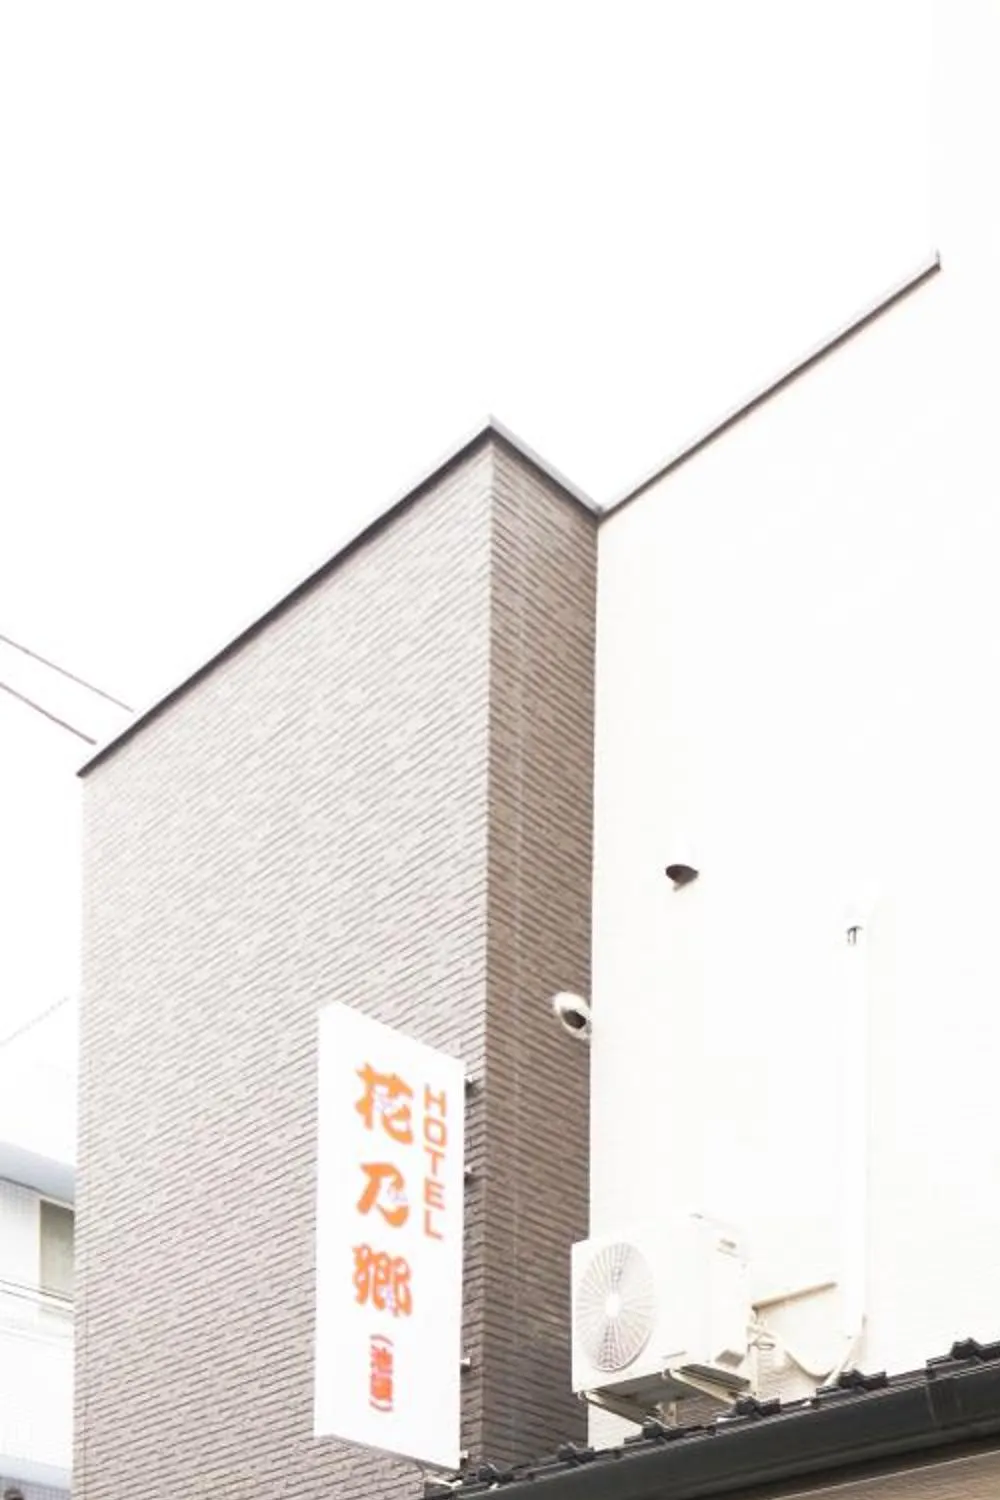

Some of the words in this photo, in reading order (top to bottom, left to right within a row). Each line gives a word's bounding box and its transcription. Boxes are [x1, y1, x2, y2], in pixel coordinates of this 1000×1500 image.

[353, 1062, 414, 1318] 花乃郷
[424, 1084, 447, 1240] HOTEL
